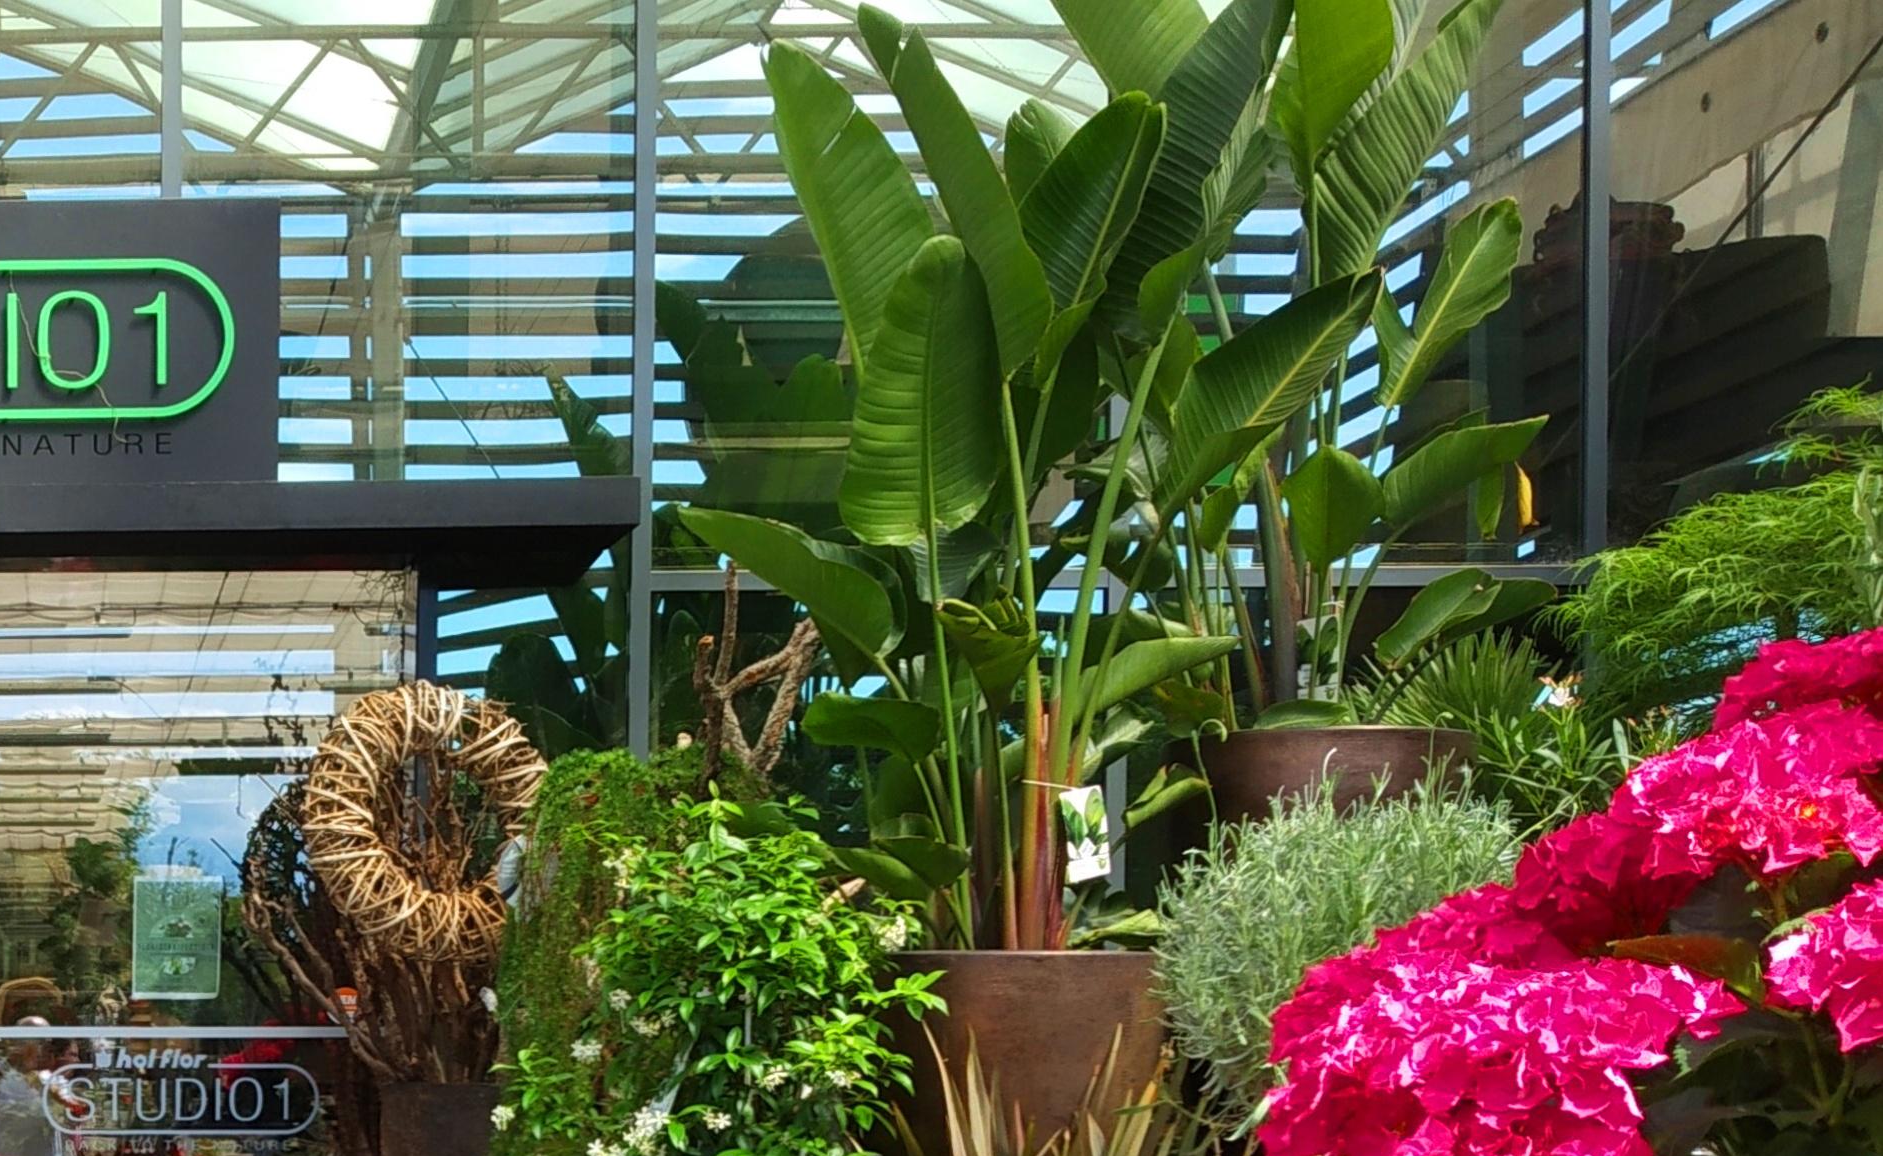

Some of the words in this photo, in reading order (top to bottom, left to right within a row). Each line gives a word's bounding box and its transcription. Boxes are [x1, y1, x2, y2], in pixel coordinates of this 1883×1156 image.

[2, 431, 174, 457] NATURE
[116, 1049, 157, 1069] hol
[160, 1049, 208, 1069] flor
